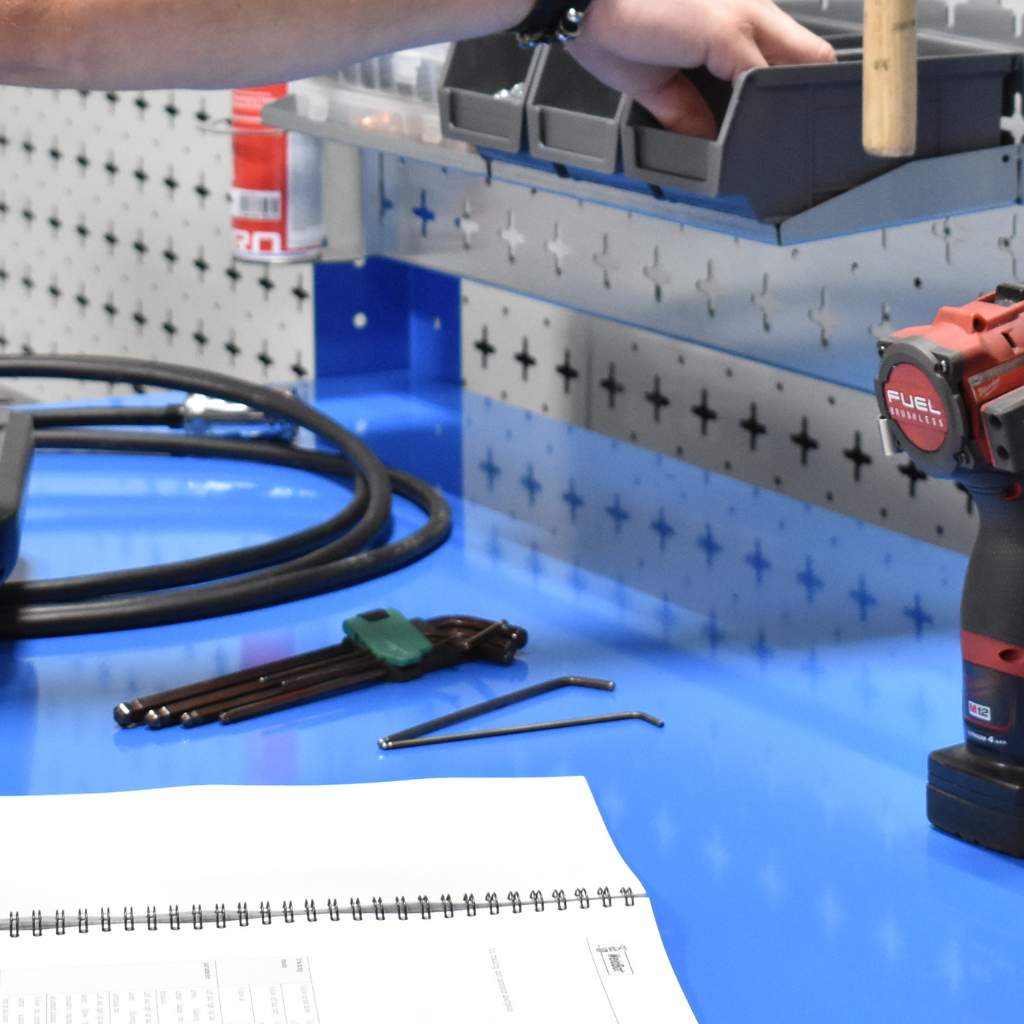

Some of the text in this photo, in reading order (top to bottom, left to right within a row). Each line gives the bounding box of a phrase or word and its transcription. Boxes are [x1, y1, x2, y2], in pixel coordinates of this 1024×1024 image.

[887, 389, 941, 415] FUEL
[889, 406, 944, 427] BRUSHLESS
[969, 701, 990, 719] M12
